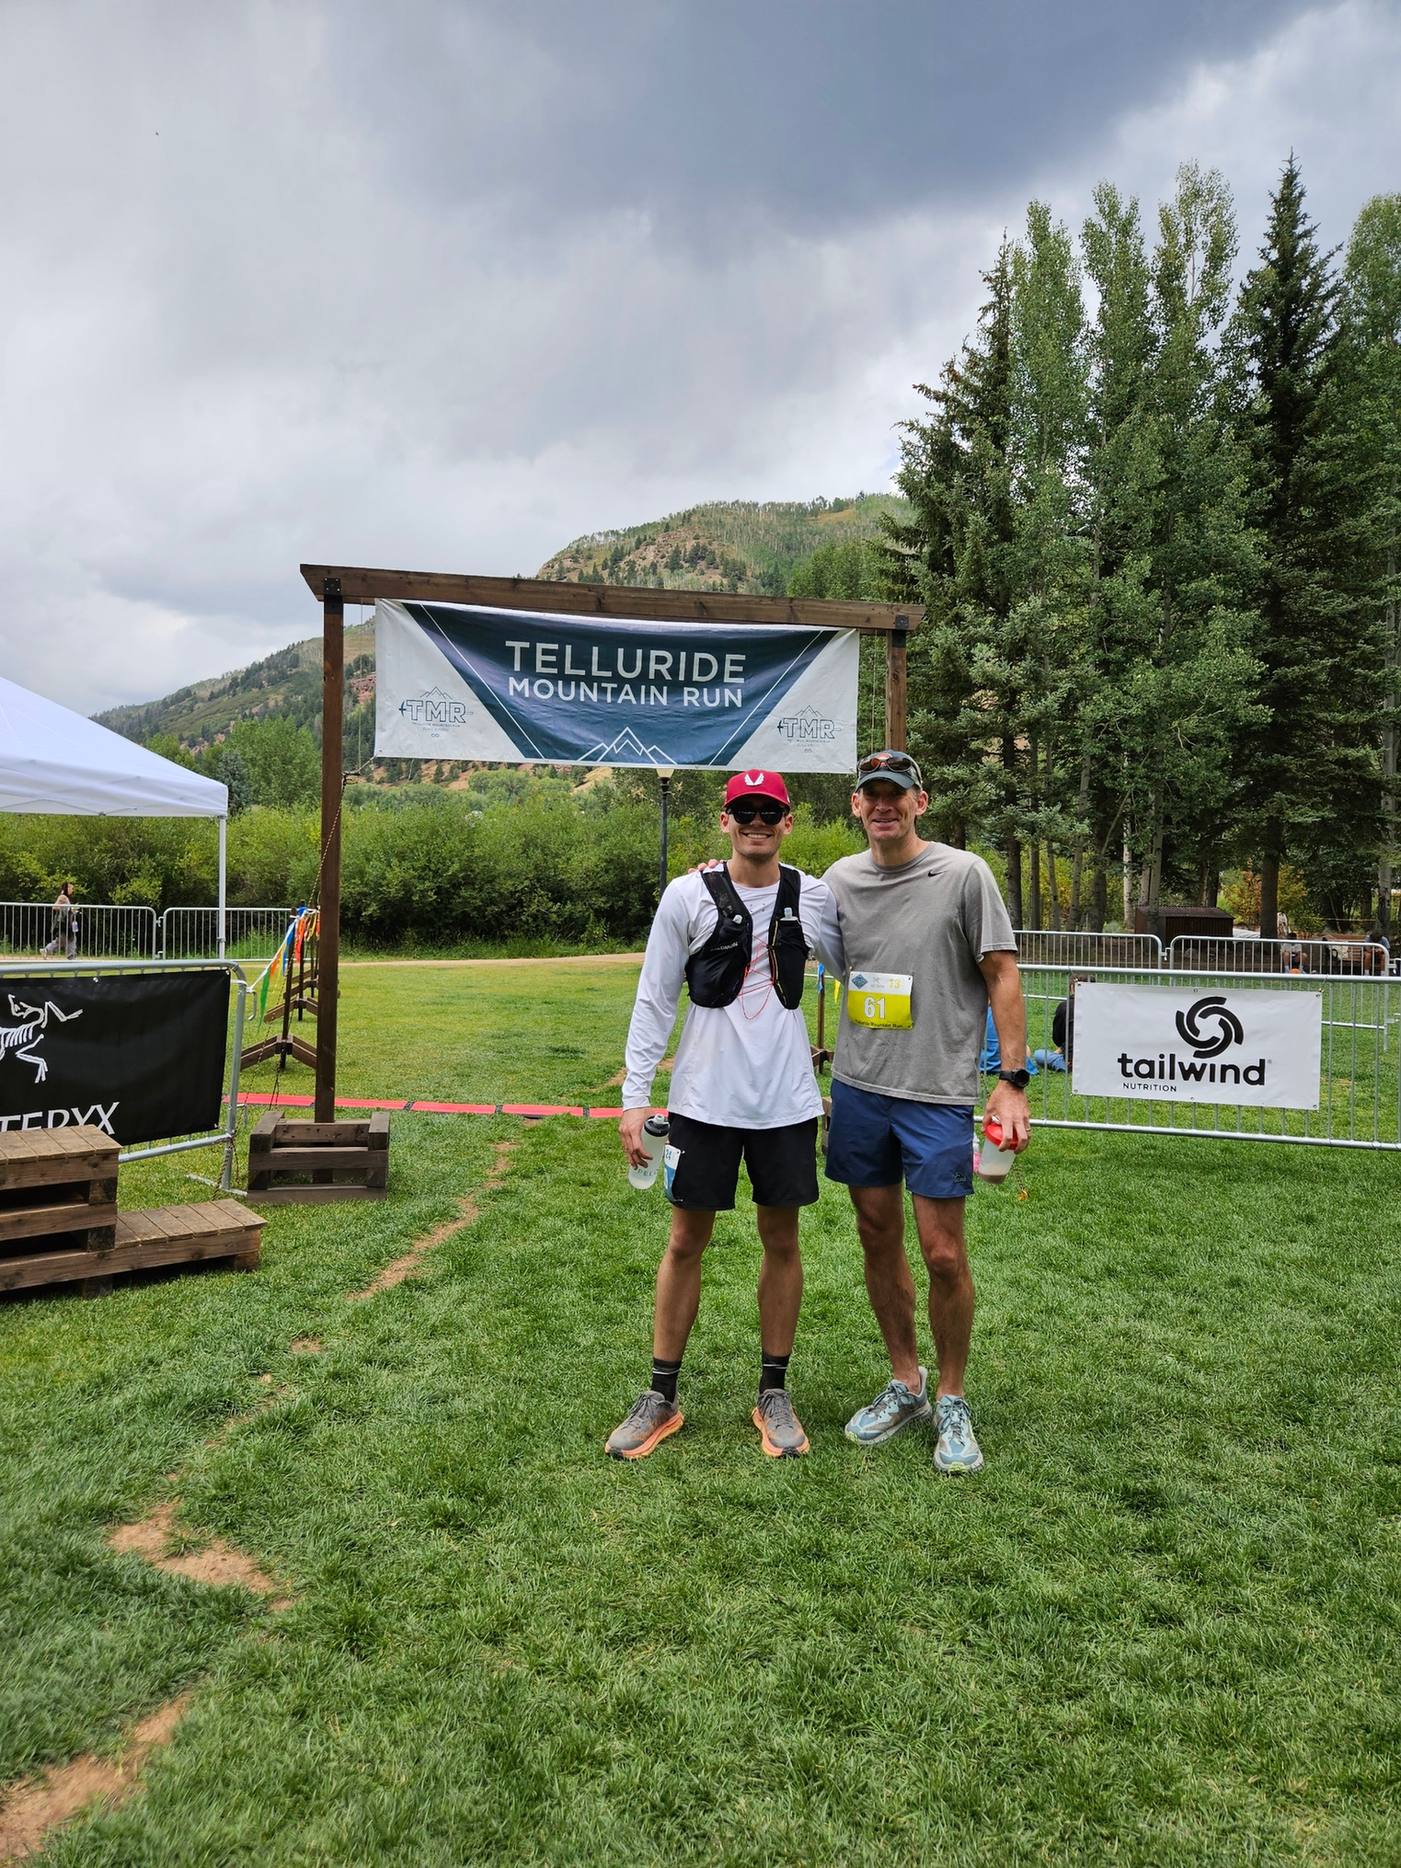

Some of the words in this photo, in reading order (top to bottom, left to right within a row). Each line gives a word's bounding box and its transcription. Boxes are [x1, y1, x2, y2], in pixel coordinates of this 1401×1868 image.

[505, 640, 747, 684] TELLURIDE
[508, 676, 668, 706] MOUNTAIN
[683, 686, 743, 708] RUN
[406, 699, 467, 724] TMR
[783, 717, 835, 740] TMR
[864, 995, 886, 1019] 61
[1117, 1053, 1266, 1086] tailwind
[1123, 1082, 1177, 1092] NUTRITION
